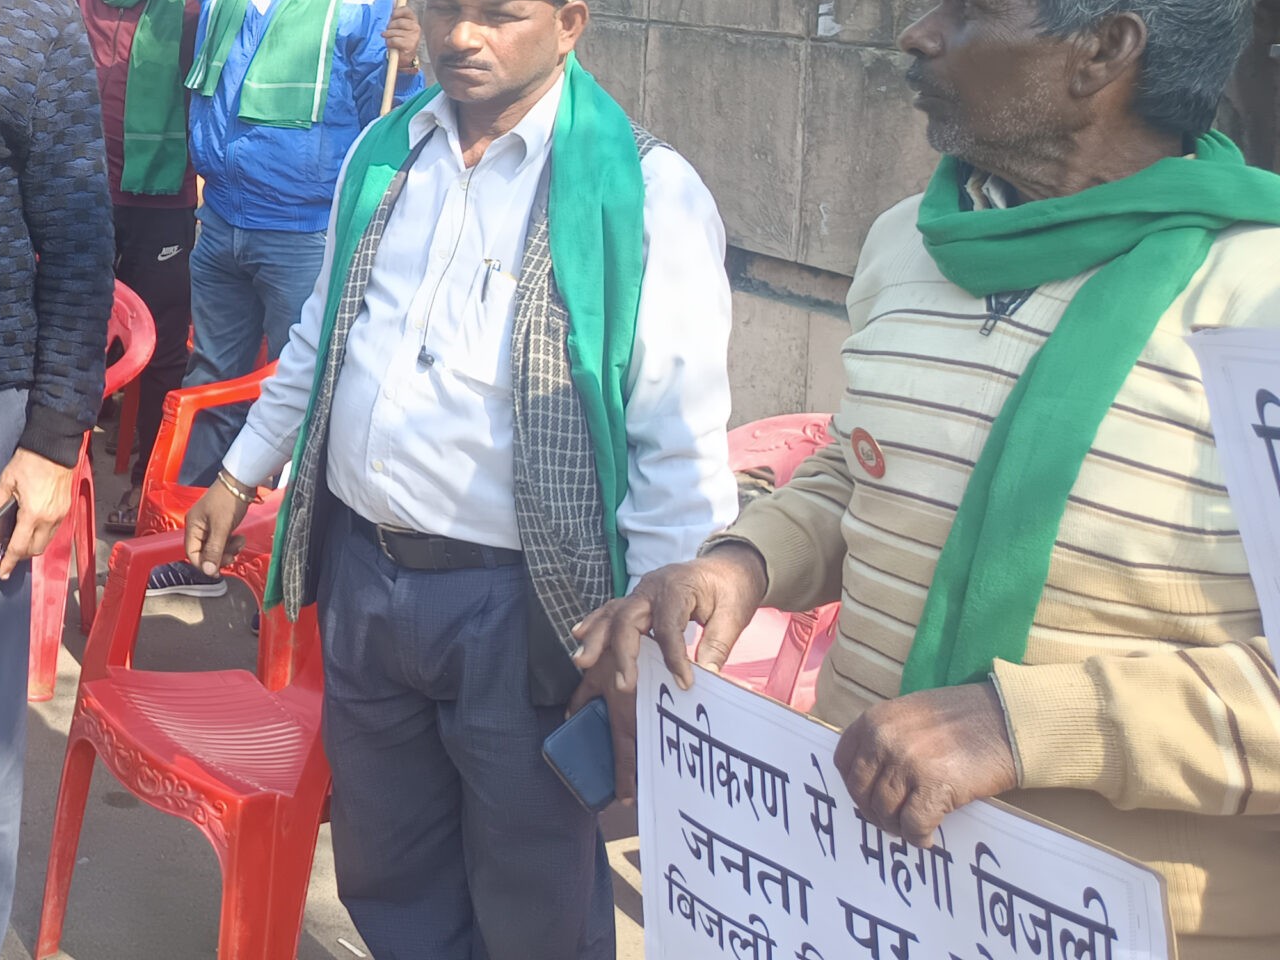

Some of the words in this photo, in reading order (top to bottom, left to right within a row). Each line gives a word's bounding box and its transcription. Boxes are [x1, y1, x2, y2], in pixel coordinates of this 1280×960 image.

[656, 683, 789, 834] निजीकरण
[804, 753, 837, 860] से
[679, 809, 813, 925] जनता
